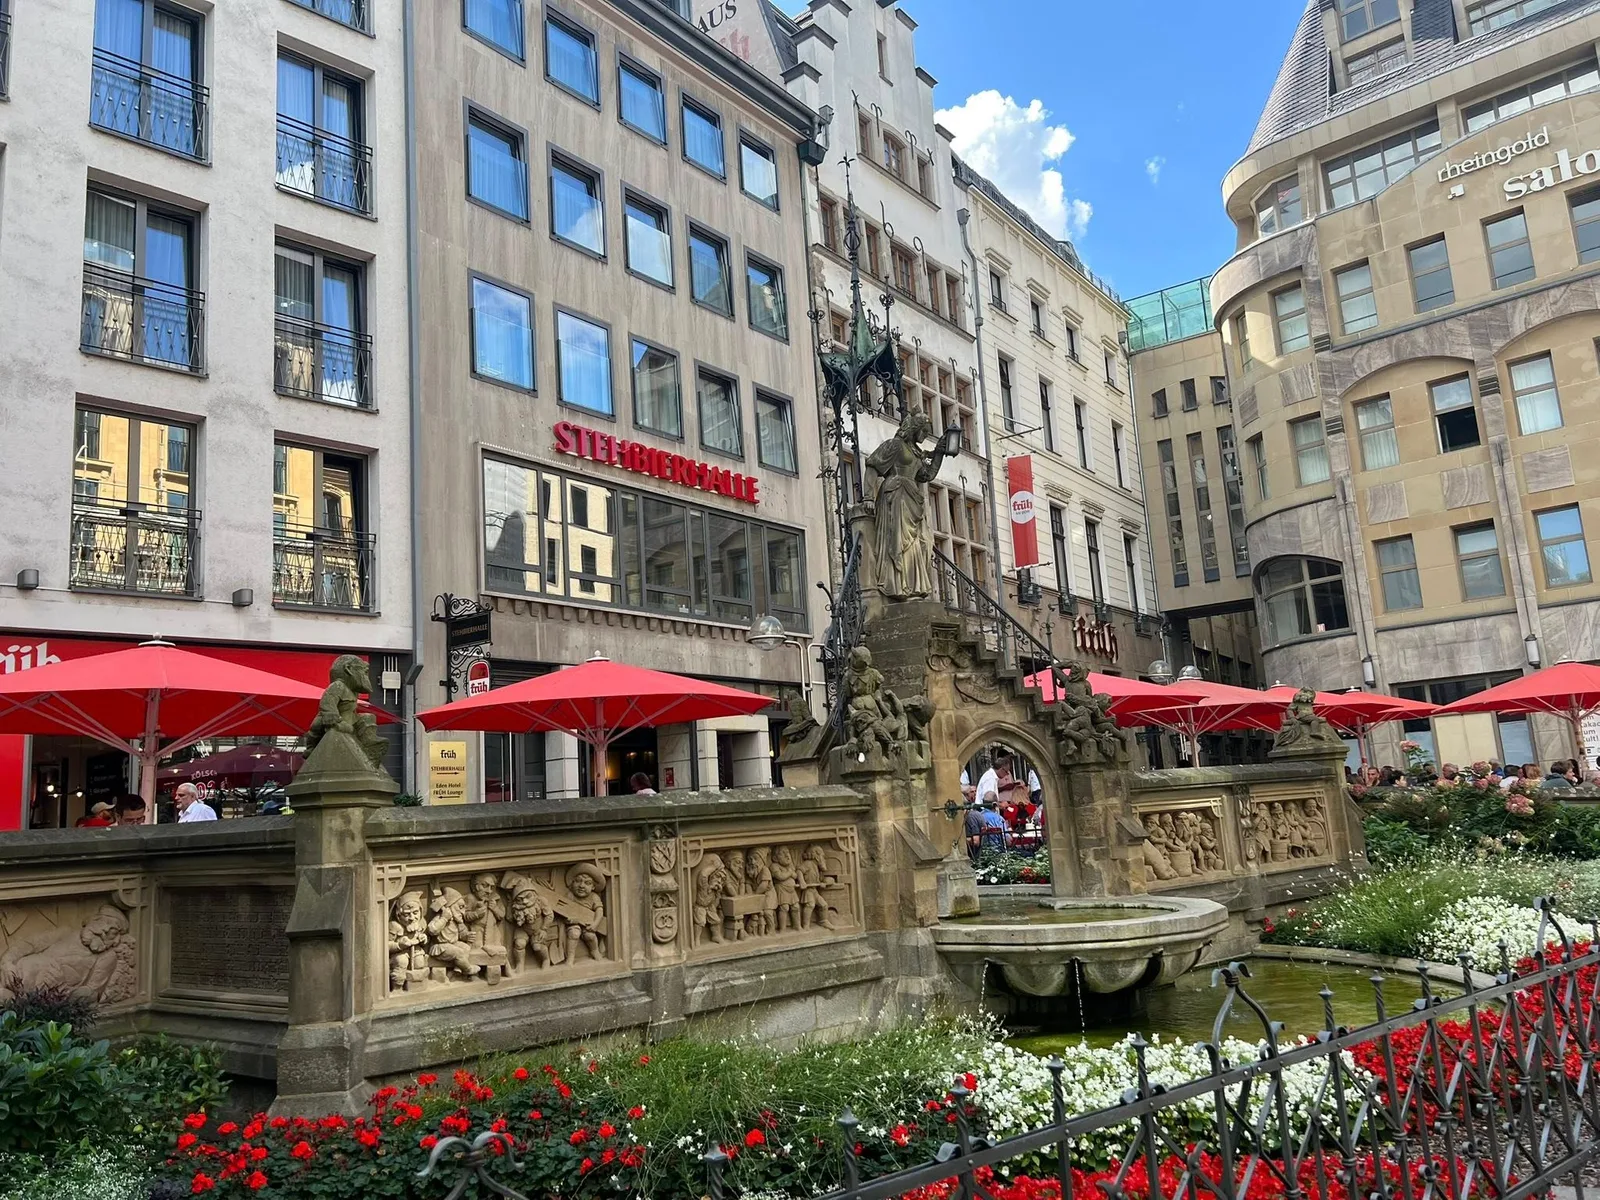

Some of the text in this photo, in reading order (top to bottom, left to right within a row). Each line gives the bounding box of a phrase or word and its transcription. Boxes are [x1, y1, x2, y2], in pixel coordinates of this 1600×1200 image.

[1437, 126, 1550, 183] rheingold
[1503, 148, 1600, 201] salo
[552, 420, 760, 504] STEHBIERHALLE
[1012, 498, 1033, 512] früh
[470, 681, 488, 695] früh
[440, 750, 457, 759] früh
